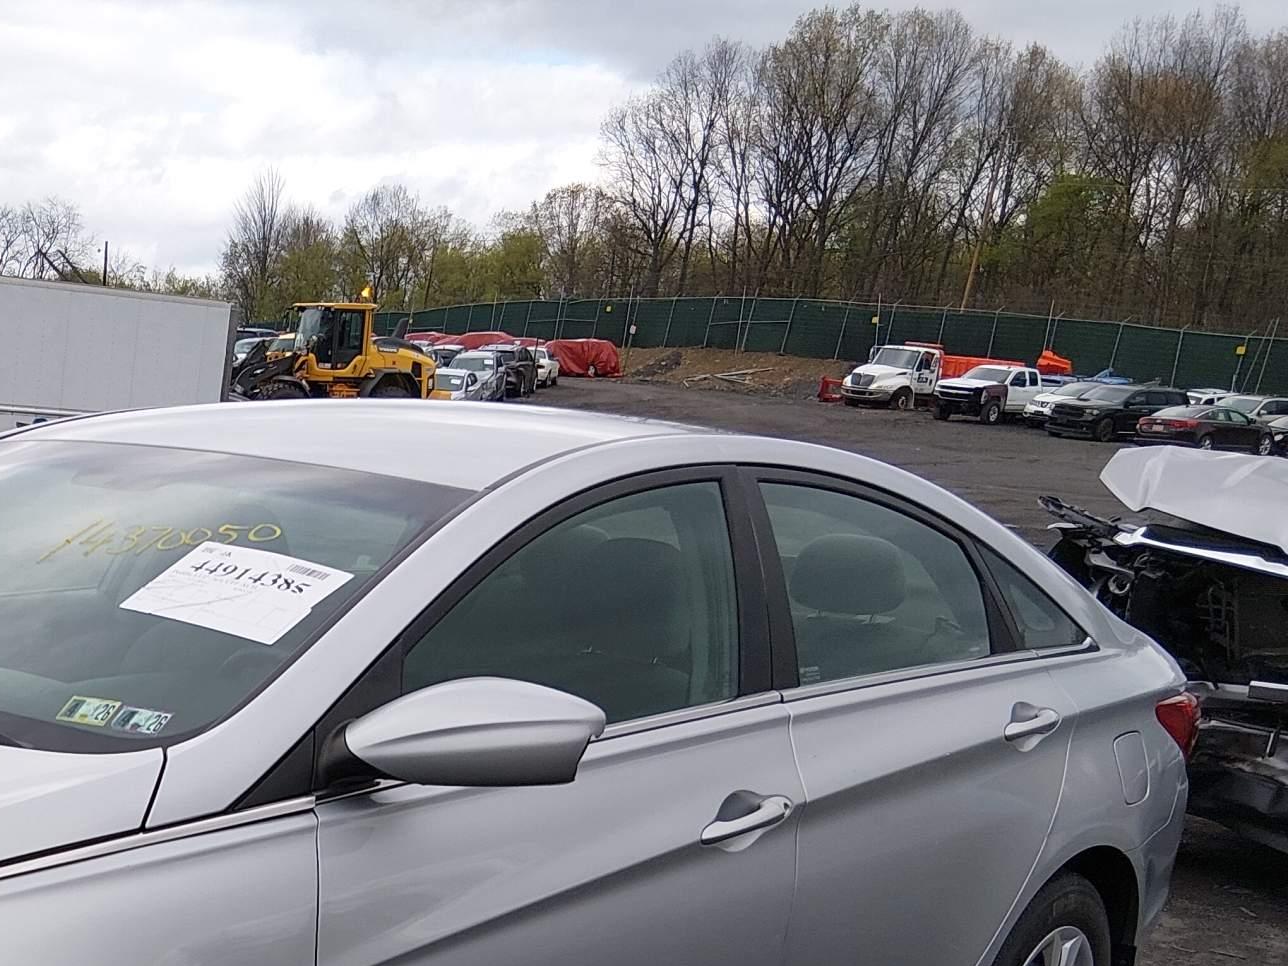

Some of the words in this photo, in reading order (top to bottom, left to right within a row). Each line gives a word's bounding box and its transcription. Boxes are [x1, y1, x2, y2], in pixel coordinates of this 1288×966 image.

[37, 517, 282, 563] 14370050
[191, 559, 312, 595] 44914385
[94, 703, 116, 721] 26
[146, 714, 168, 733] 26
